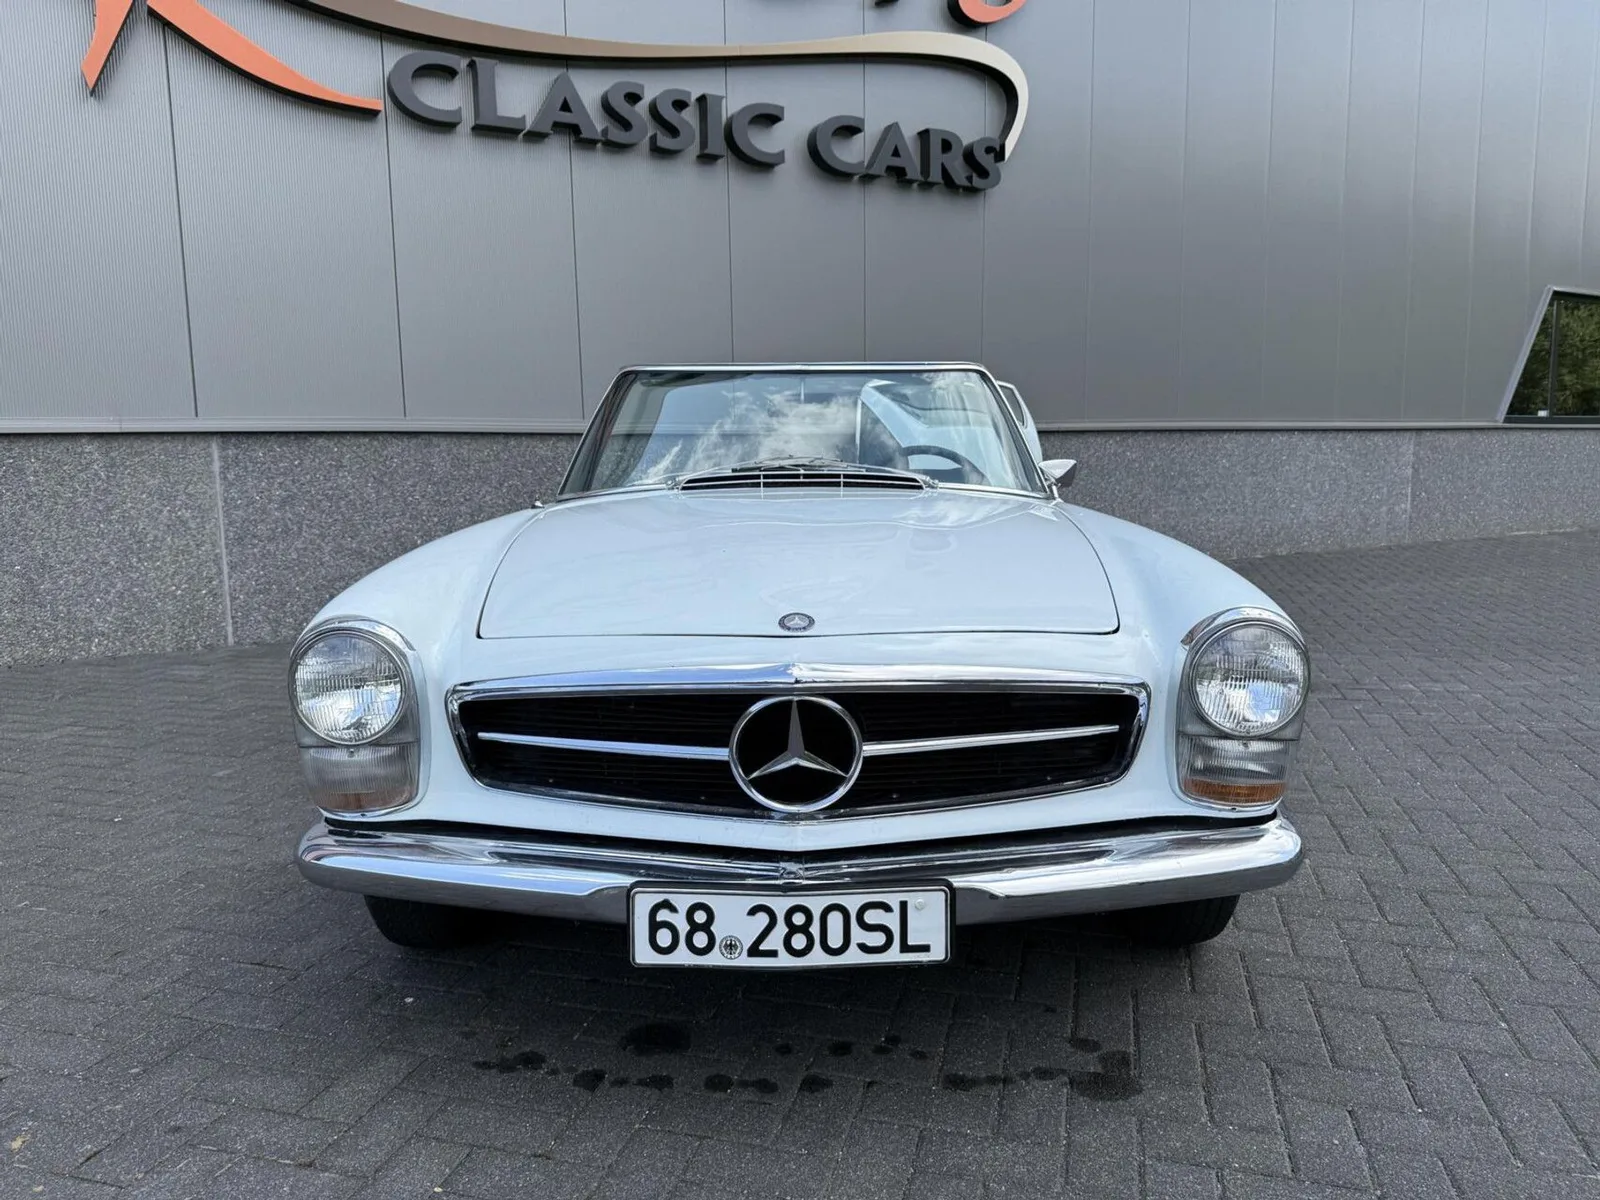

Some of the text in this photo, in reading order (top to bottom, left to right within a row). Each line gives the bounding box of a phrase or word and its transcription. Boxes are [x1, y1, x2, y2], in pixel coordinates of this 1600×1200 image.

[387, 50, 1004, 191] CLASSIC CARS
[648, 898, 717, 957] 68
[746, 900, 931, 959] 280SL
